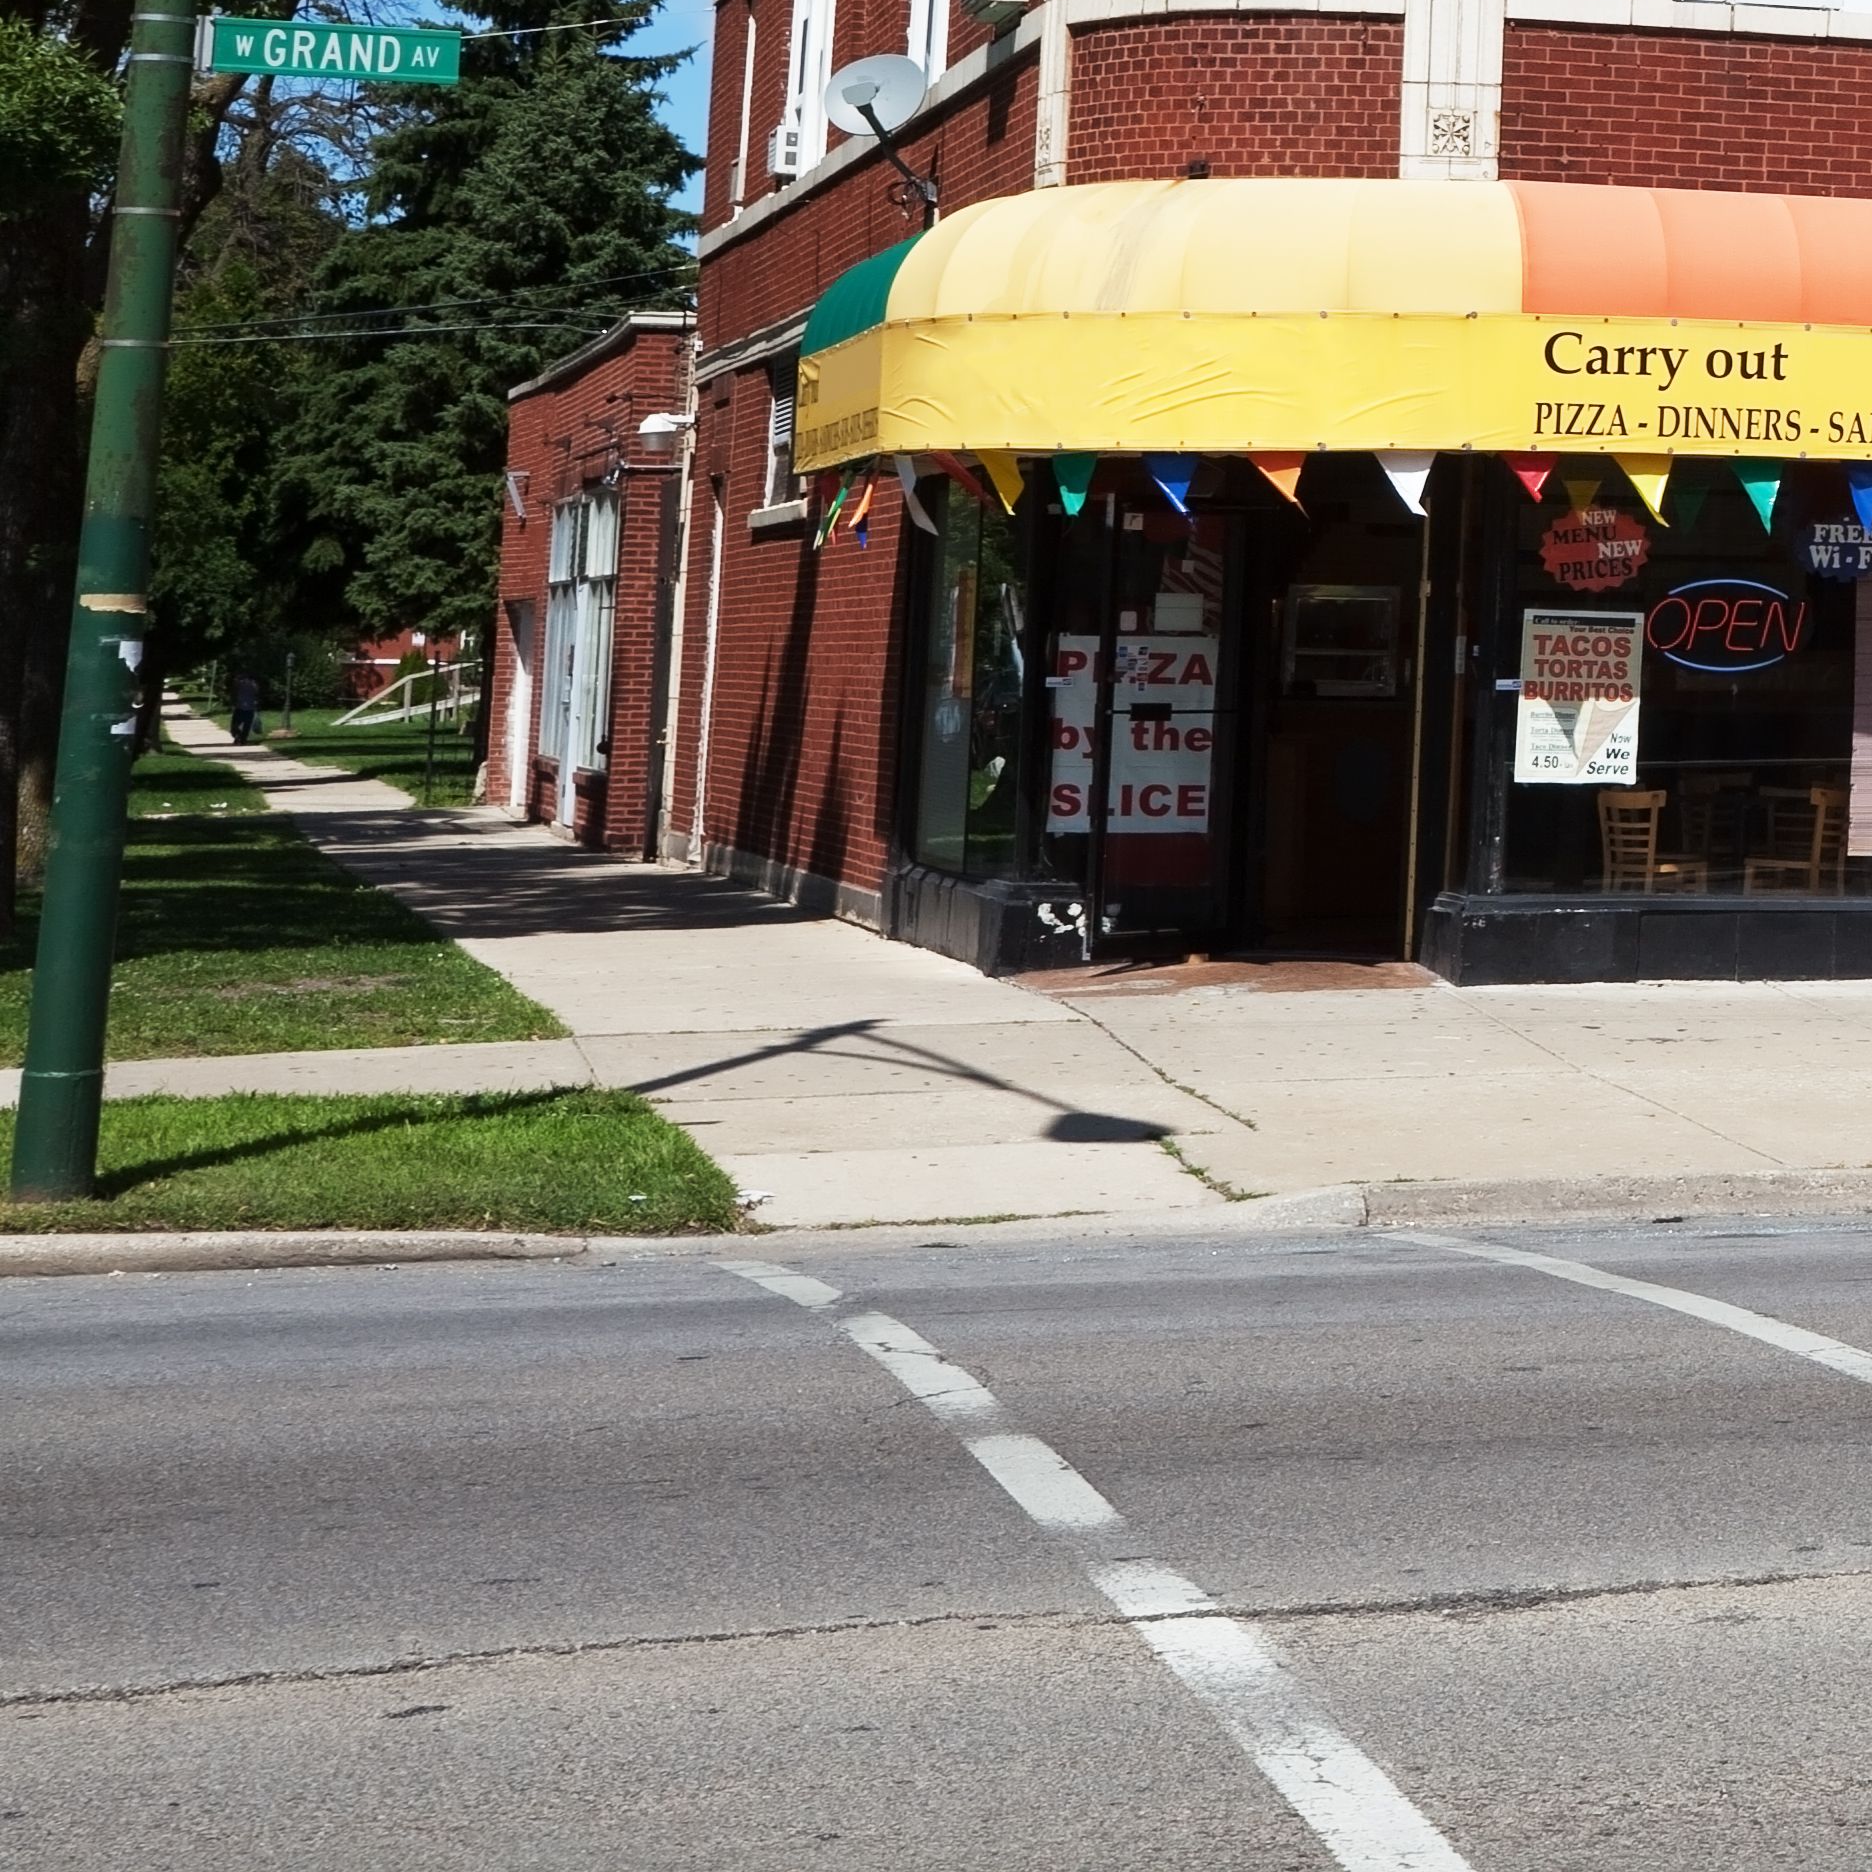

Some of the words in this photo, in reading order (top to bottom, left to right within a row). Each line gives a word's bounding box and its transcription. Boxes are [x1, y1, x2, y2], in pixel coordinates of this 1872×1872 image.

[235, 35, 254, 57] W
[264, 28, 401, 73] GRAND
[411, 46, 440, 68] AV
[1544, 331, 1688, 391] Carry
[1706, 342, 1789, 381] out
[1533, 401, 1629, 436] PIZZA
[1657, 405, 1801, 442] DINNERS
[1582, 510, 1616, 526] NEW
[1553, 526, 1616, 545] MENU
[1598, 540, 1642, 559] NEW
[1559, 558, 1633, 582] PRICES
[1648, 597, 1806, 653] OPEN
[1533, 634, 1632, 658] TACOS
[1534, 658, 1628, 680] TORTAS
[1524, 680, 1633, 702] BURRITOS
[1131, 720, 1215, 752] the
[1532, 755, 1559, 768] 4.50
[1606, 748, 1630, 760] We
[1587, 761, 1629, 775] Serve
